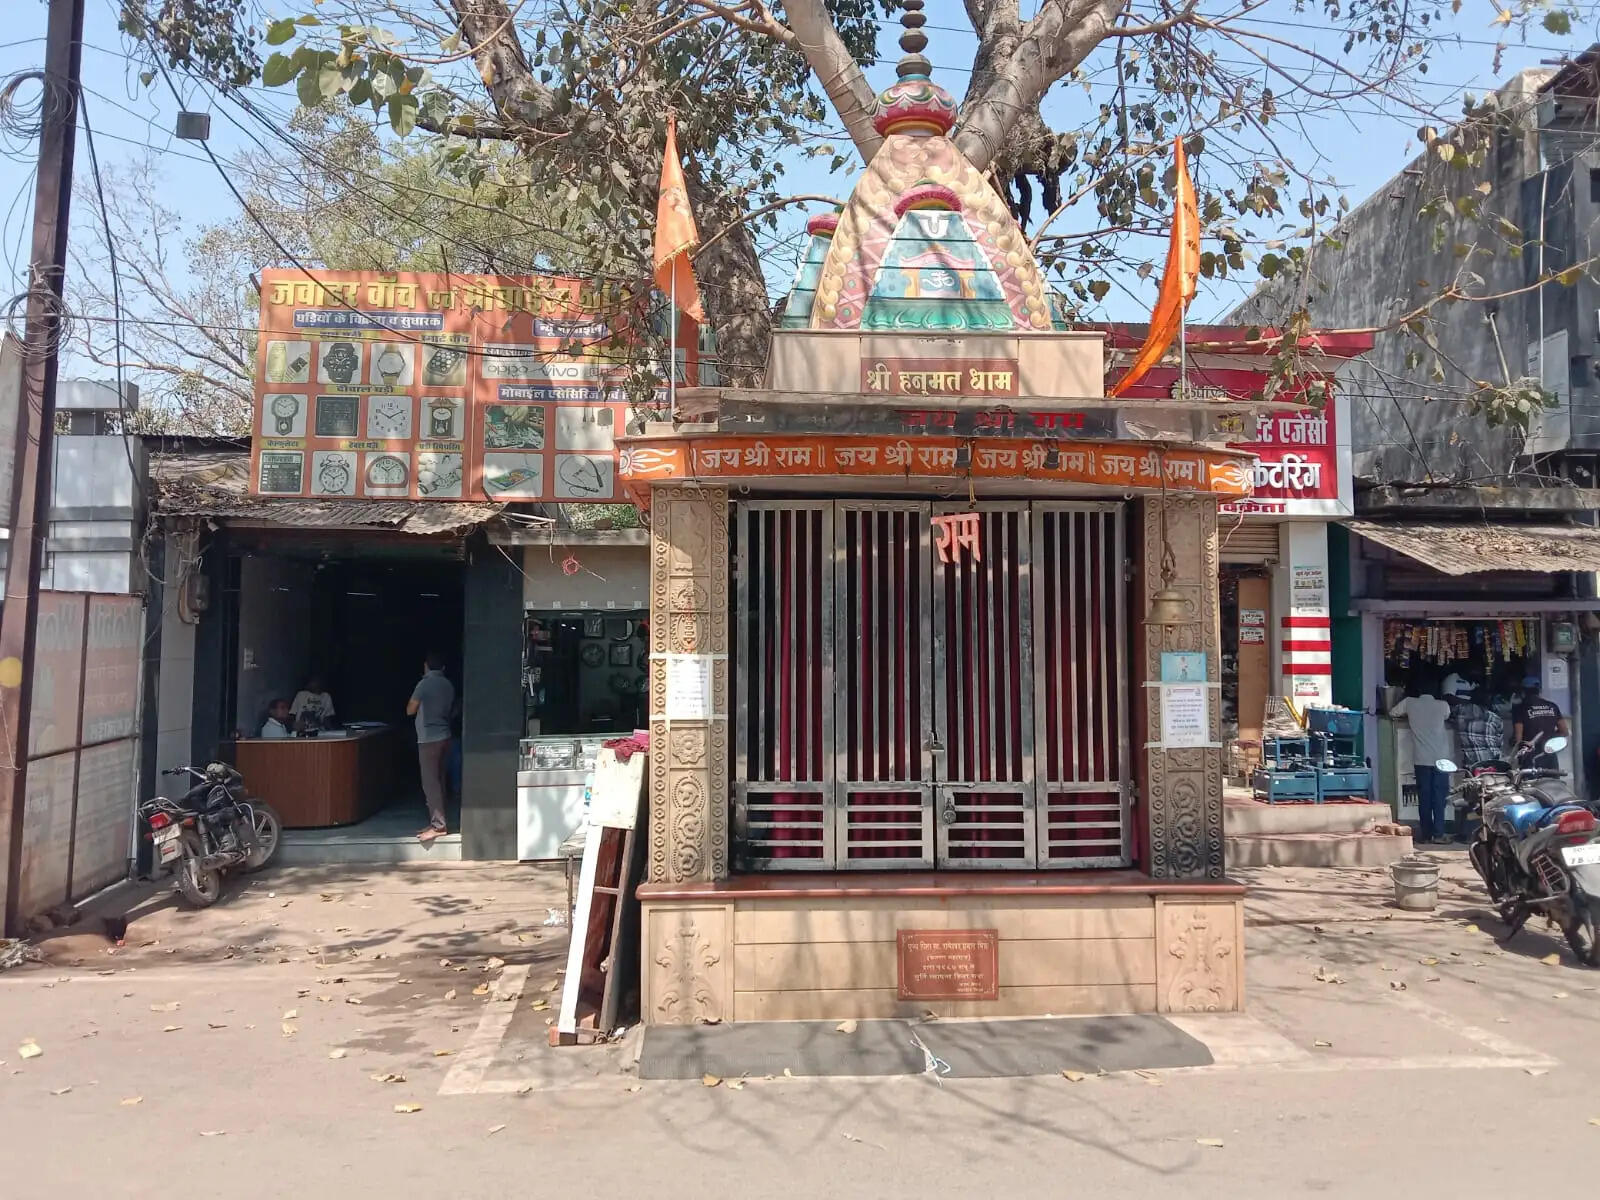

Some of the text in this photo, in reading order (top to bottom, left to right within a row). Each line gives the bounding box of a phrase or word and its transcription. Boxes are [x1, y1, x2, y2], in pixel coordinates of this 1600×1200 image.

[269, 280, 361, 307] जवाहर
[542, 365, 579, 377] vivo
[866, 363, 891, 391] श्री
[968, 368, 1013, 391] धाम
[501, 386, 545, 398] मोबाईल
[701, 449, 741, 468] जय
[744, 441, 770, 467] श्री
[774, 447, 812, 468] राम
[835, 447, 879, 466] जय
[884, 440, 914, 466] श्री
[918, 447, 958, 469] राम
[976, 448, 1018, 469] जय
[1022, 444, 1047, 469] श्री
[1055, 451, 1086, 472] ाम
[1101, 454, 1136, 476] जय
[1139, 450, 1161, 478] श्री
[1164, 460, 1196, 481] राम
[930, 512, 981, 563] राम
